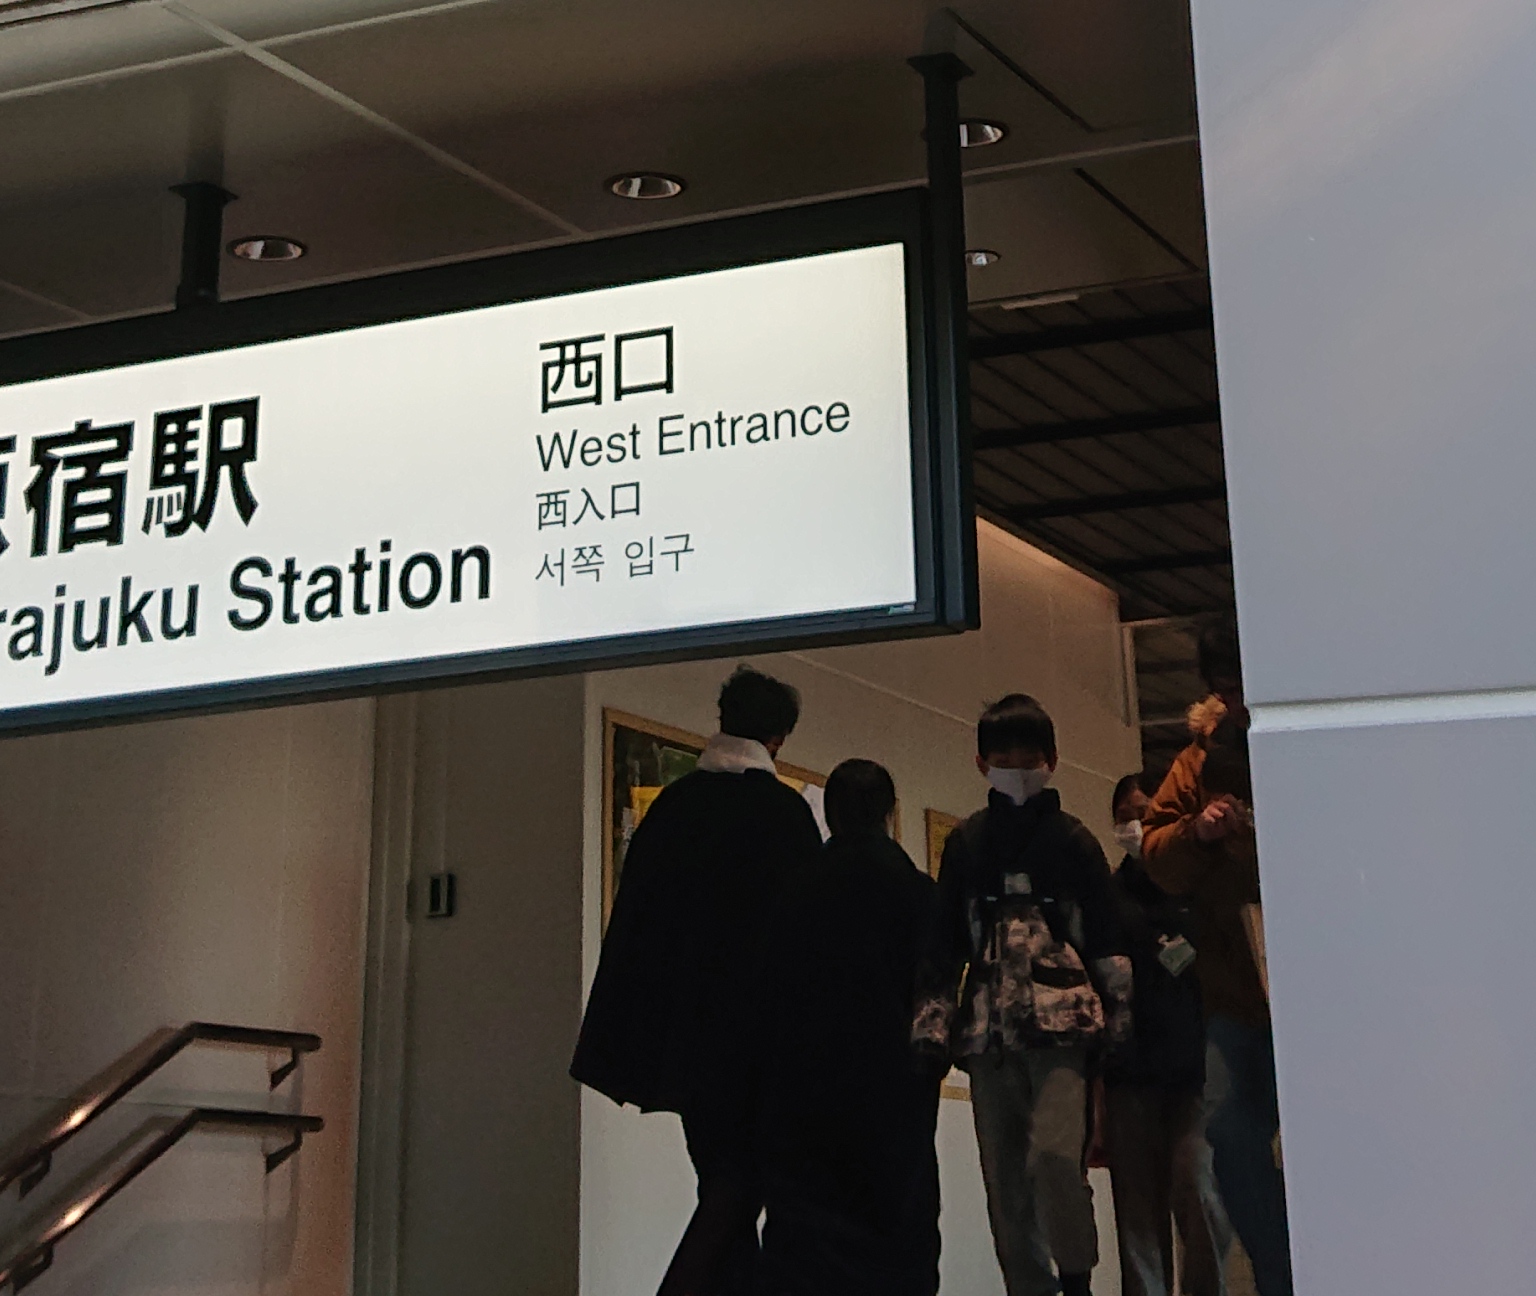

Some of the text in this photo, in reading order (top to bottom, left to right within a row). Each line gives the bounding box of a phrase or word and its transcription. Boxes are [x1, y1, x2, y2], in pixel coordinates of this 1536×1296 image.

[537, 325, 675, 414] 西口
[535, 400, 852, 473] West Entrance
[535, 480, 642, 531] 西入口
[225, 537, 493, 634] Station
[534, 532, 696, 588] 서쪽 입구
